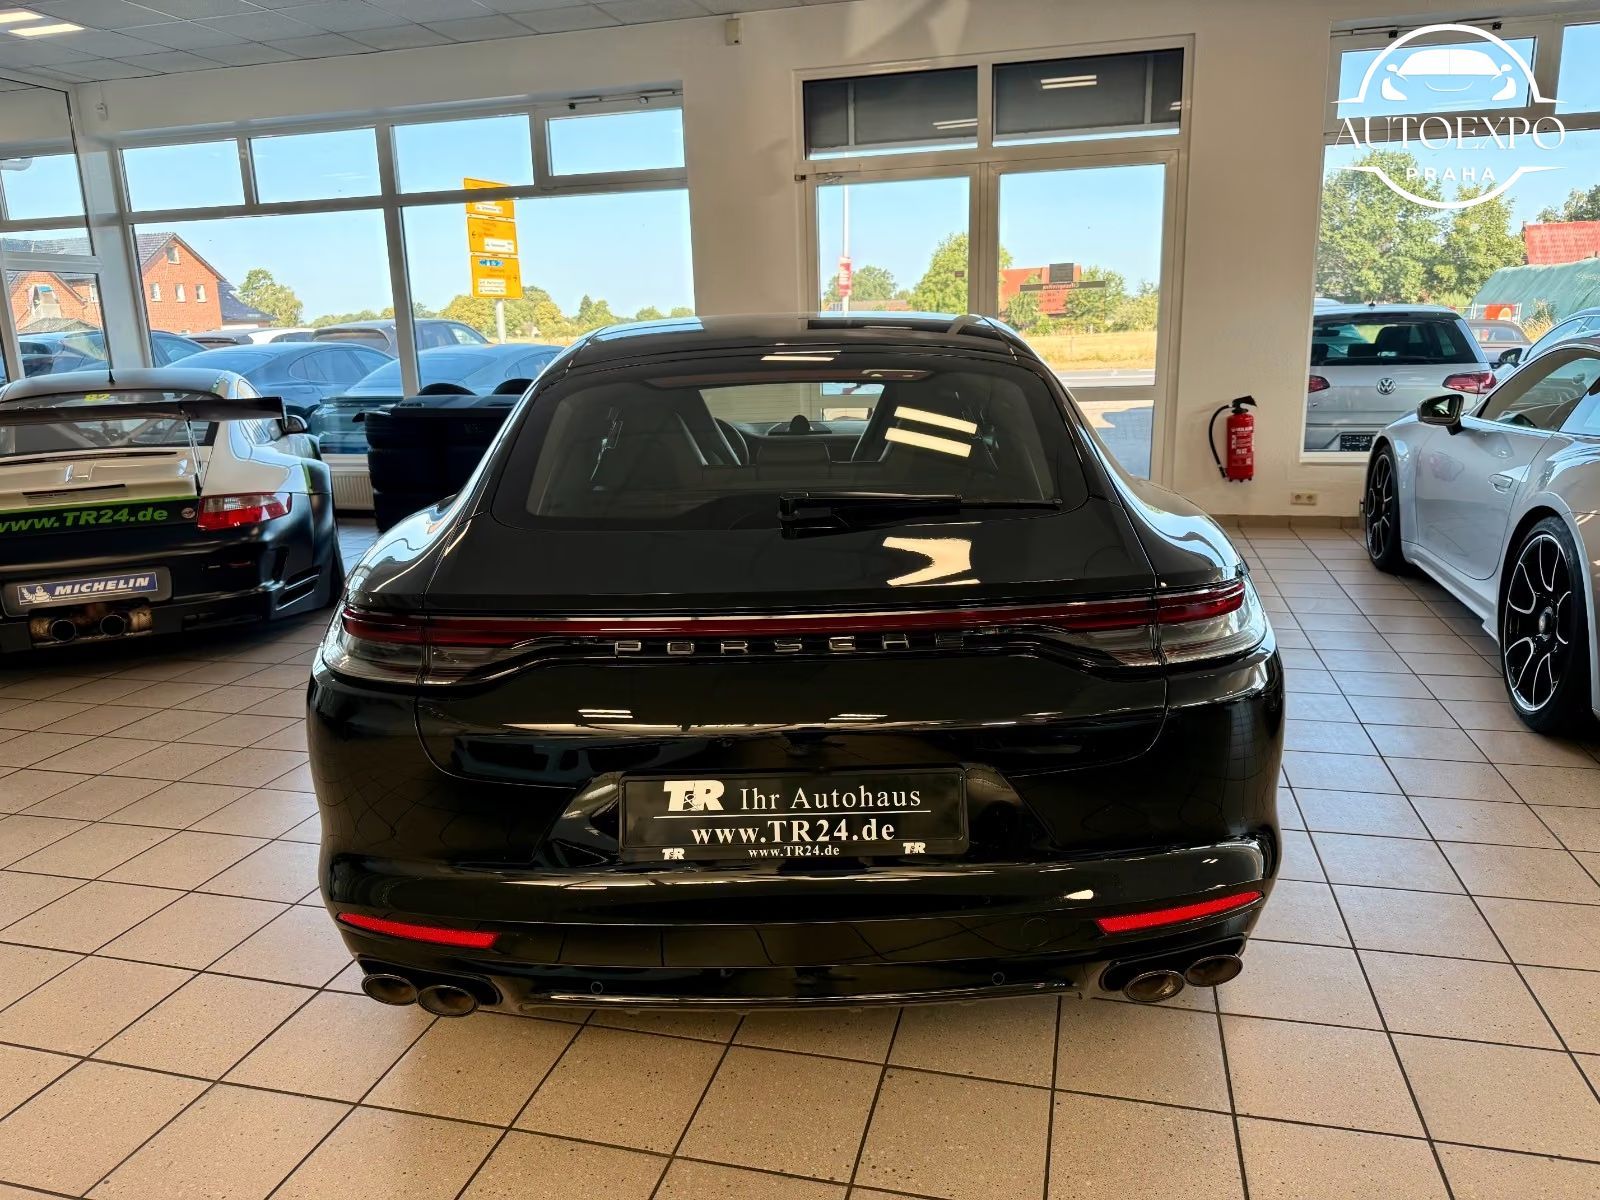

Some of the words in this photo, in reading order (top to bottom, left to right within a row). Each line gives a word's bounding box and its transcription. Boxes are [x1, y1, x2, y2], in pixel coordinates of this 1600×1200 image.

[54, 576, 150, 596] MICHELIN
[740, 787, 780, 810] Ihr
[789, 785, 921, 810] Autohaus
[691, 818, 895, 845] www.TR24.de
[748, 845, 840, 857] www.TR24.de
